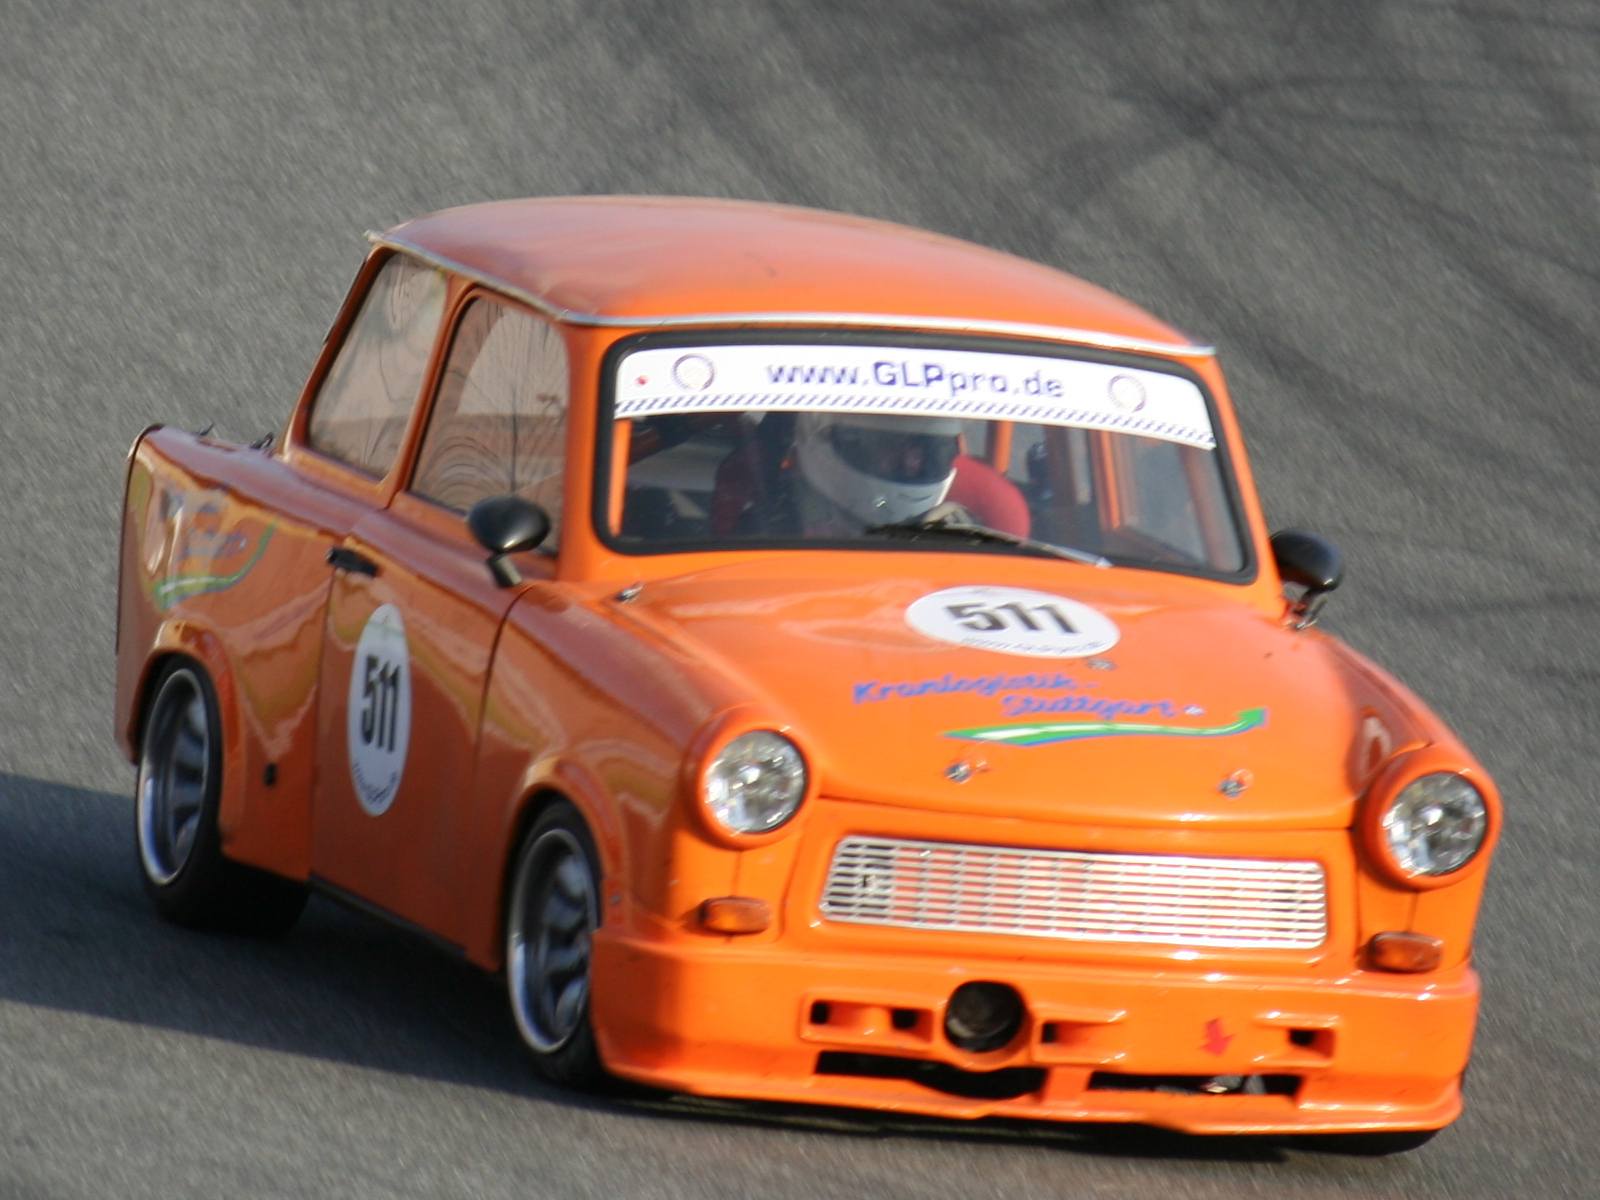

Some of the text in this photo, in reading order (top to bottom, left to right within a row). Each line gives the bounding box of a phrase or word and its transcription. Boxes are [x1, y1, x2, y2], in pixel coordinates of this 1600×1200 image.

[767, 360, 1065, 398] www.GLPpro.de
[944, 601, 1078, 634] 511
[361, 654, 400, 753] 511
